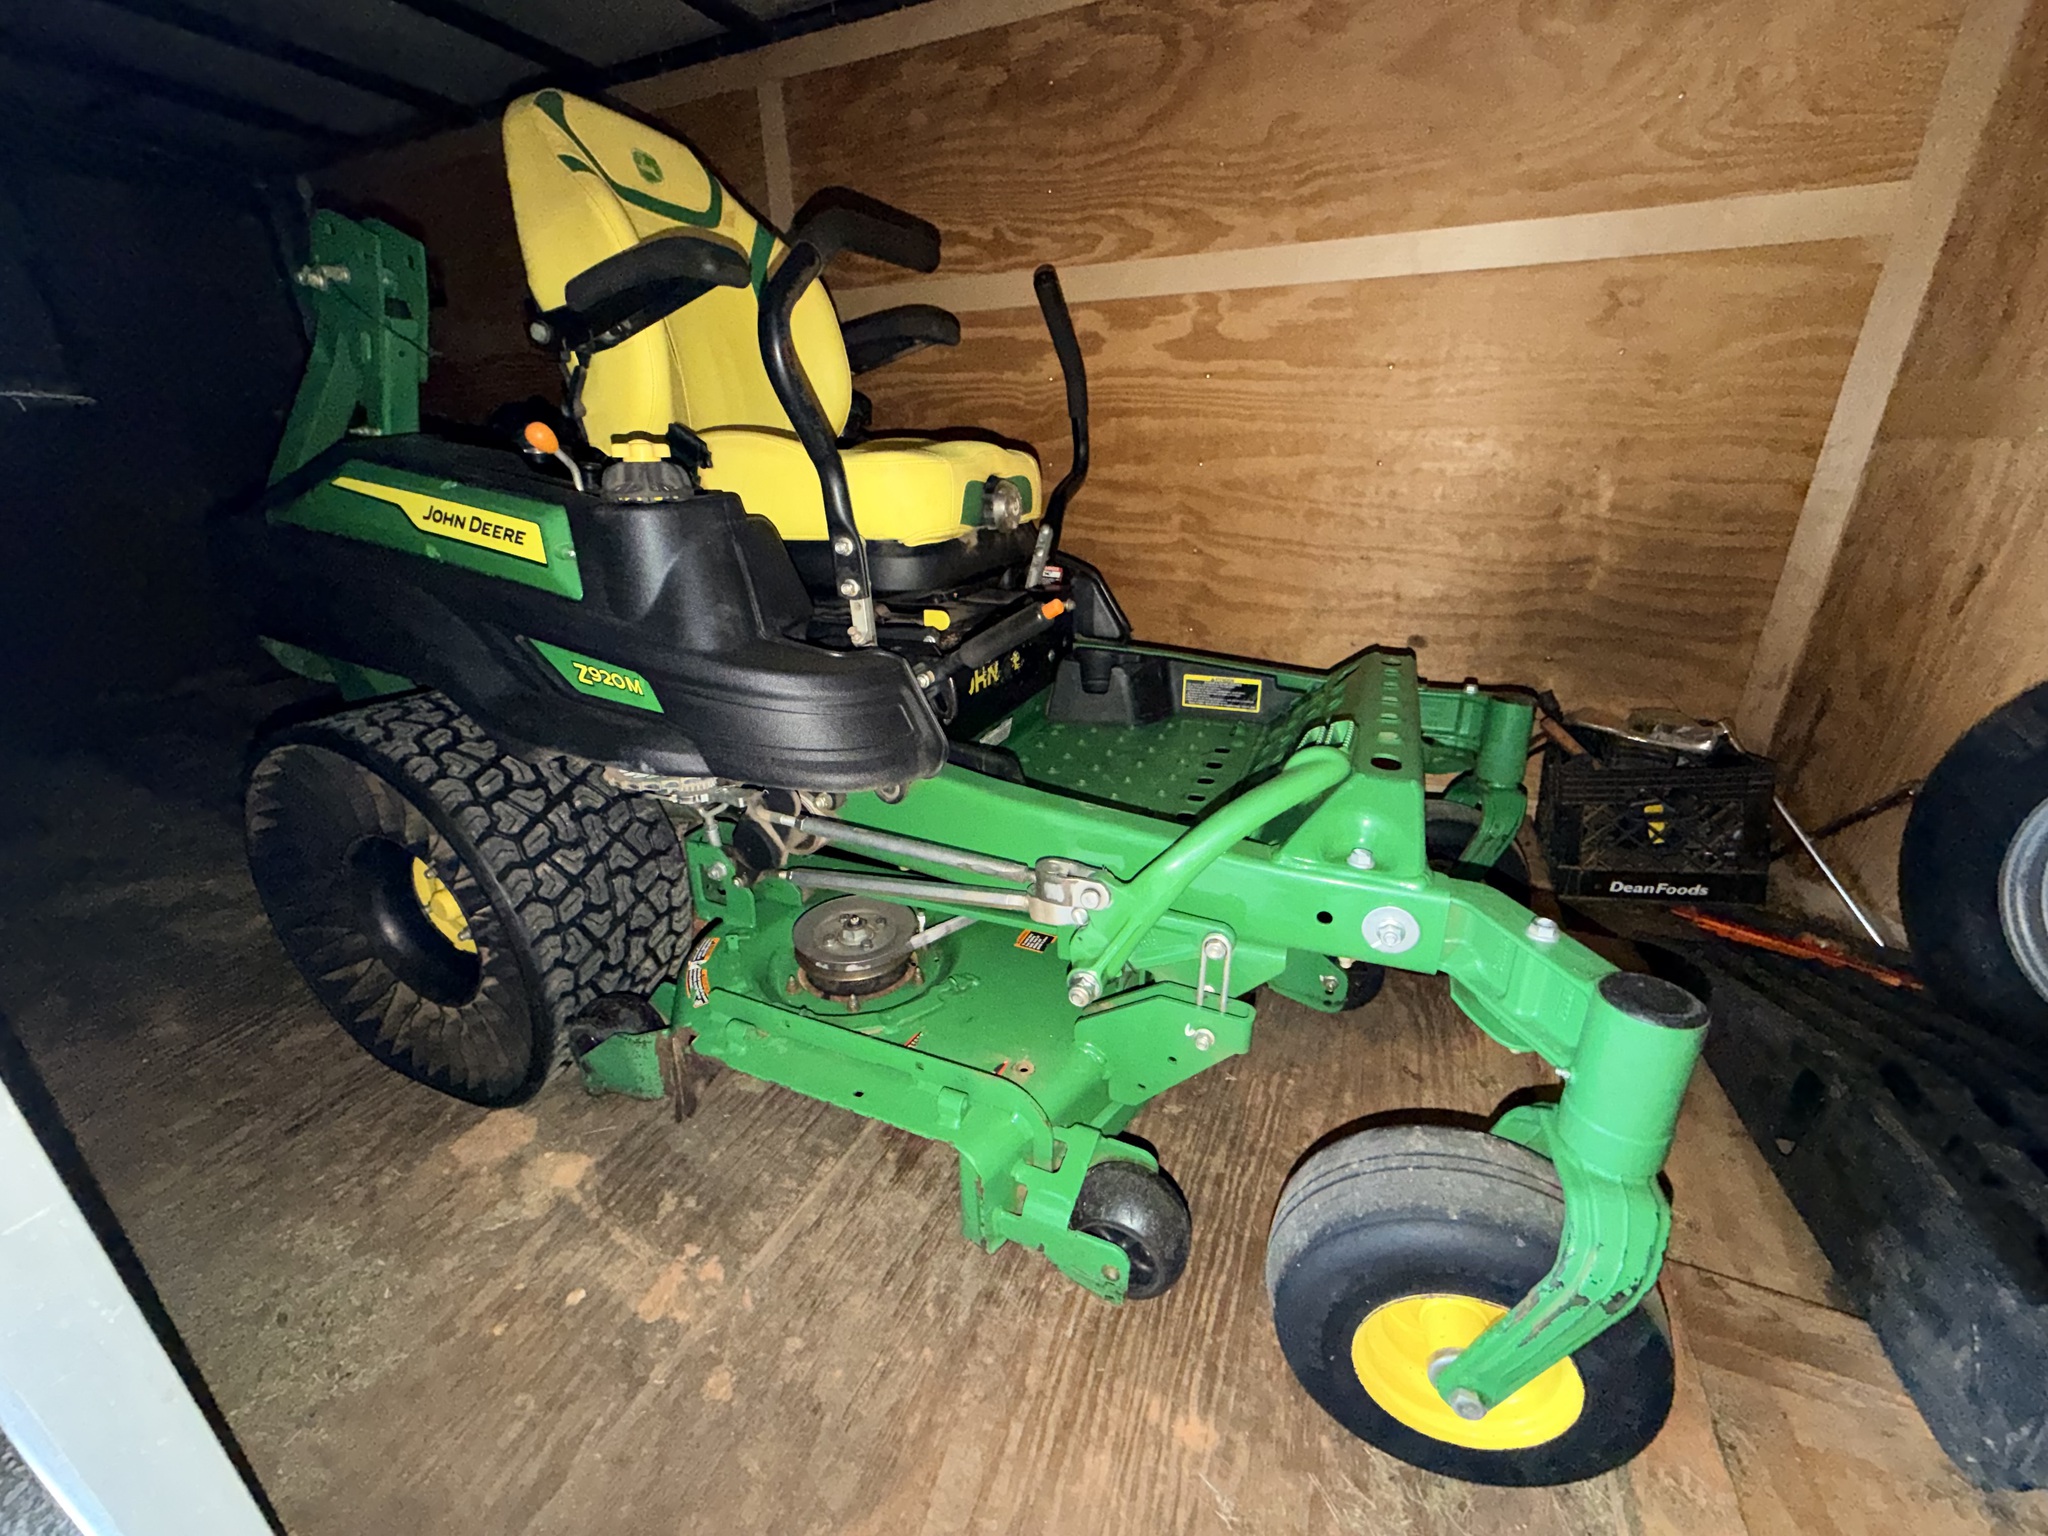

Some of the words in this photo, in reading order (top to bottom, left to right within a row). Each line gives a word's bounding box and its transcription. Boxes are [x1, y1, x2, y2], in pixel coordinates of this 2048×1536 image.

[422, 505, 466, 529] JOHN
[469, 515, 526, 545] DEERE
[572, 661, 644, 695] Z920M
